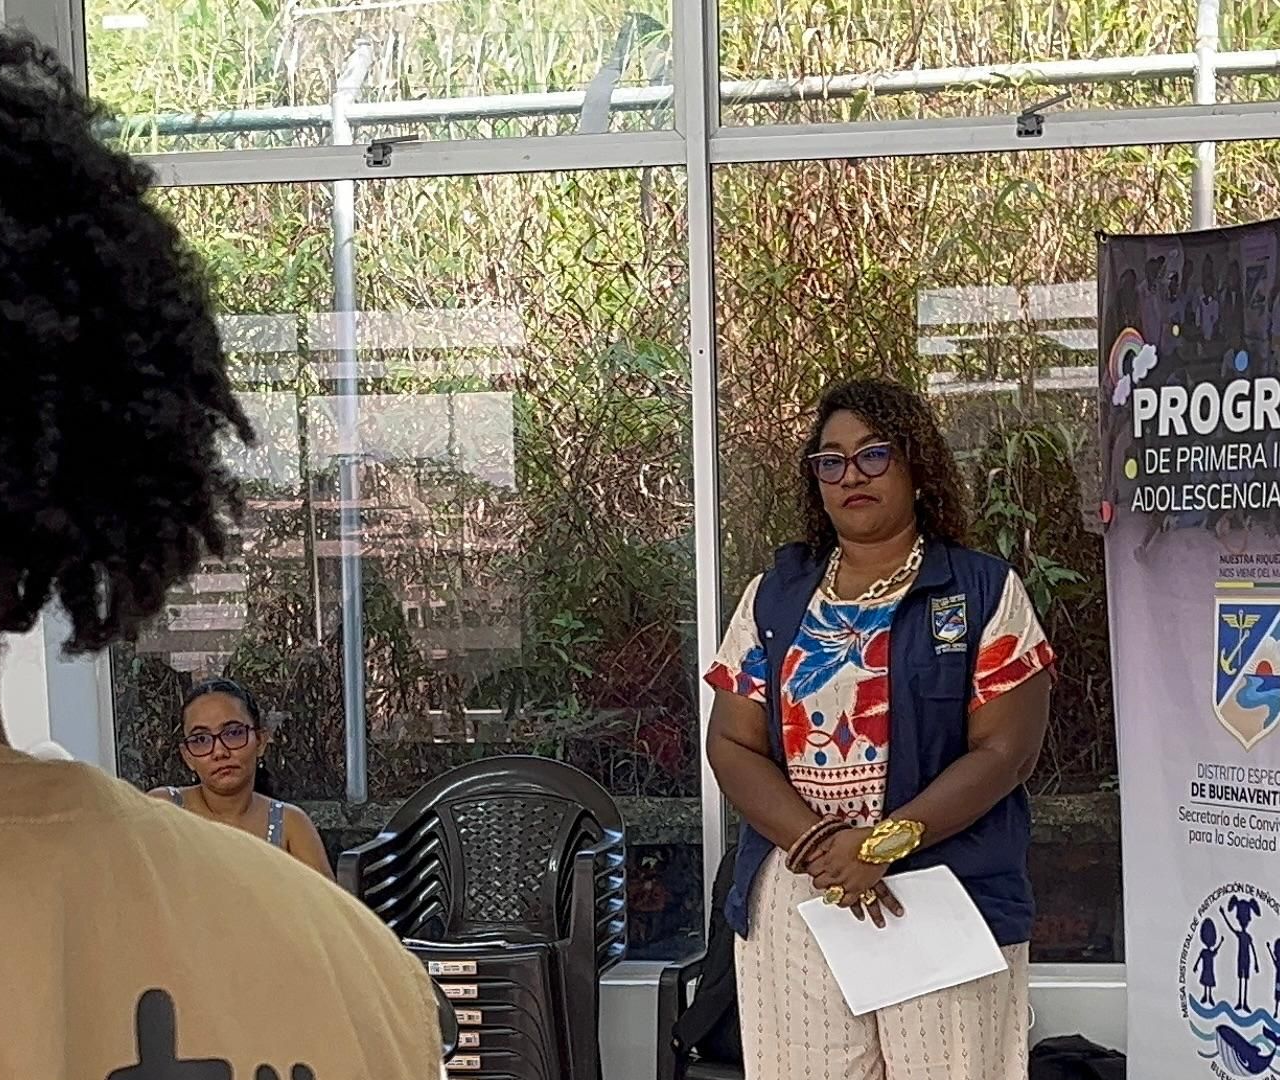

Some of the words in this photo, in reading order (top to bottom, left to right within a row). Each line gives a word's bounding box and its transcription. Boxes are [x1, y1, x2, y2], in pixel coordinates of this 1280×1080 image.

[1145, 446, 1171, 474] DE
[1177, 440, 1268, 472] PRIMERA
[1219, 553, 1254, 564] NUESTRA
[1197, 763, 1245, 782] DISTRITO
[1191, 783, 1207, 799] DE
[1233, 813, 1247, 829] de
[1189, 829, 1212, 845] para
[1214, 830, 1224, 845] la
[1227, 832, 1276, 852] Sociedad
[1198, 881, 1244, 918] PARTICIPACIÓN
[1244, 883, 1255, 897] DE
[1190, 916, 1200, 935] DE
[1178, 934, 1196, 984] DISTRITAL
[1178, 986, 1189, 1018] MESA
